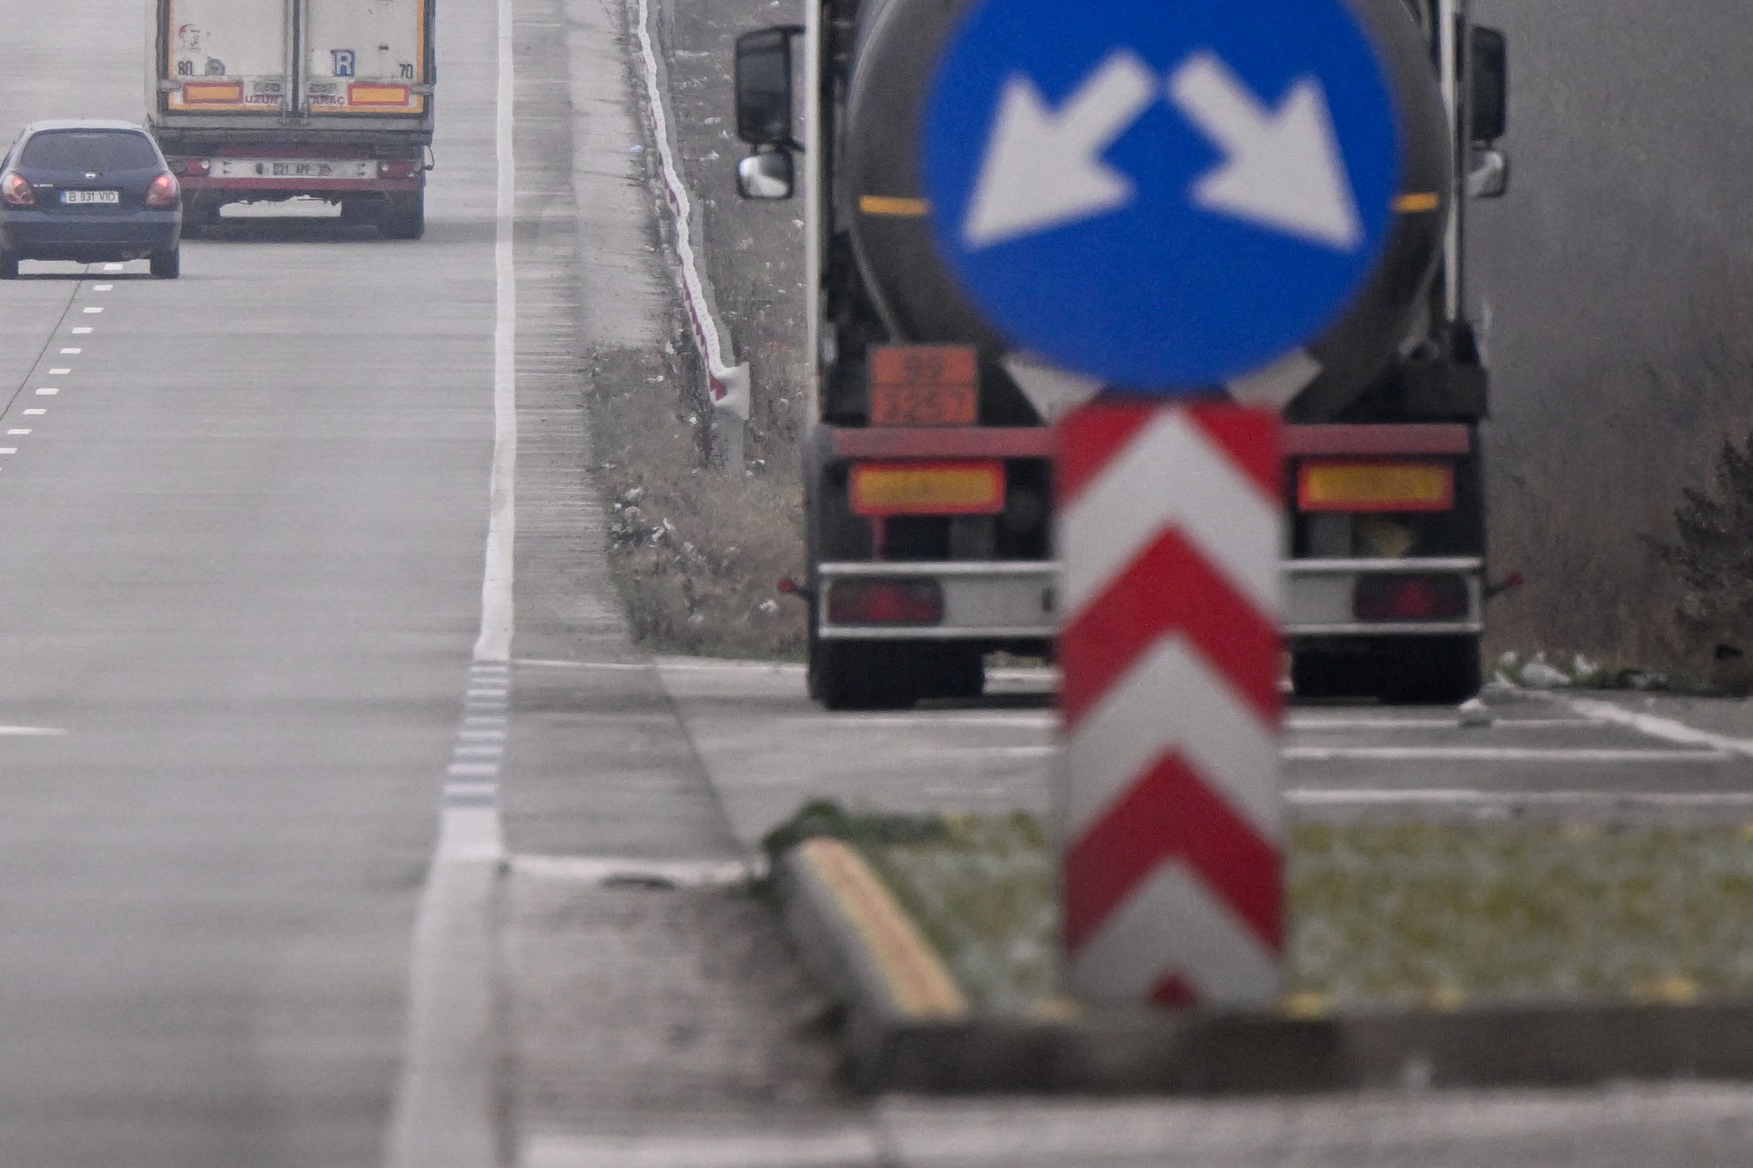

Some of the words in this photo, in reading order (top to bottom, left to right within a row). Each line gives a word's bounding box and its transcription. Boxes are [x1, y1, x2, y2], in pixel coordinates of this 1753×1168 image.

[178, 60, 193, 76] 80
[335, 51, 352, 75] R
[399, 63, 414, 79] 70
[69, 192, 76, 202] B
[80, 192, 95, 202] 931
